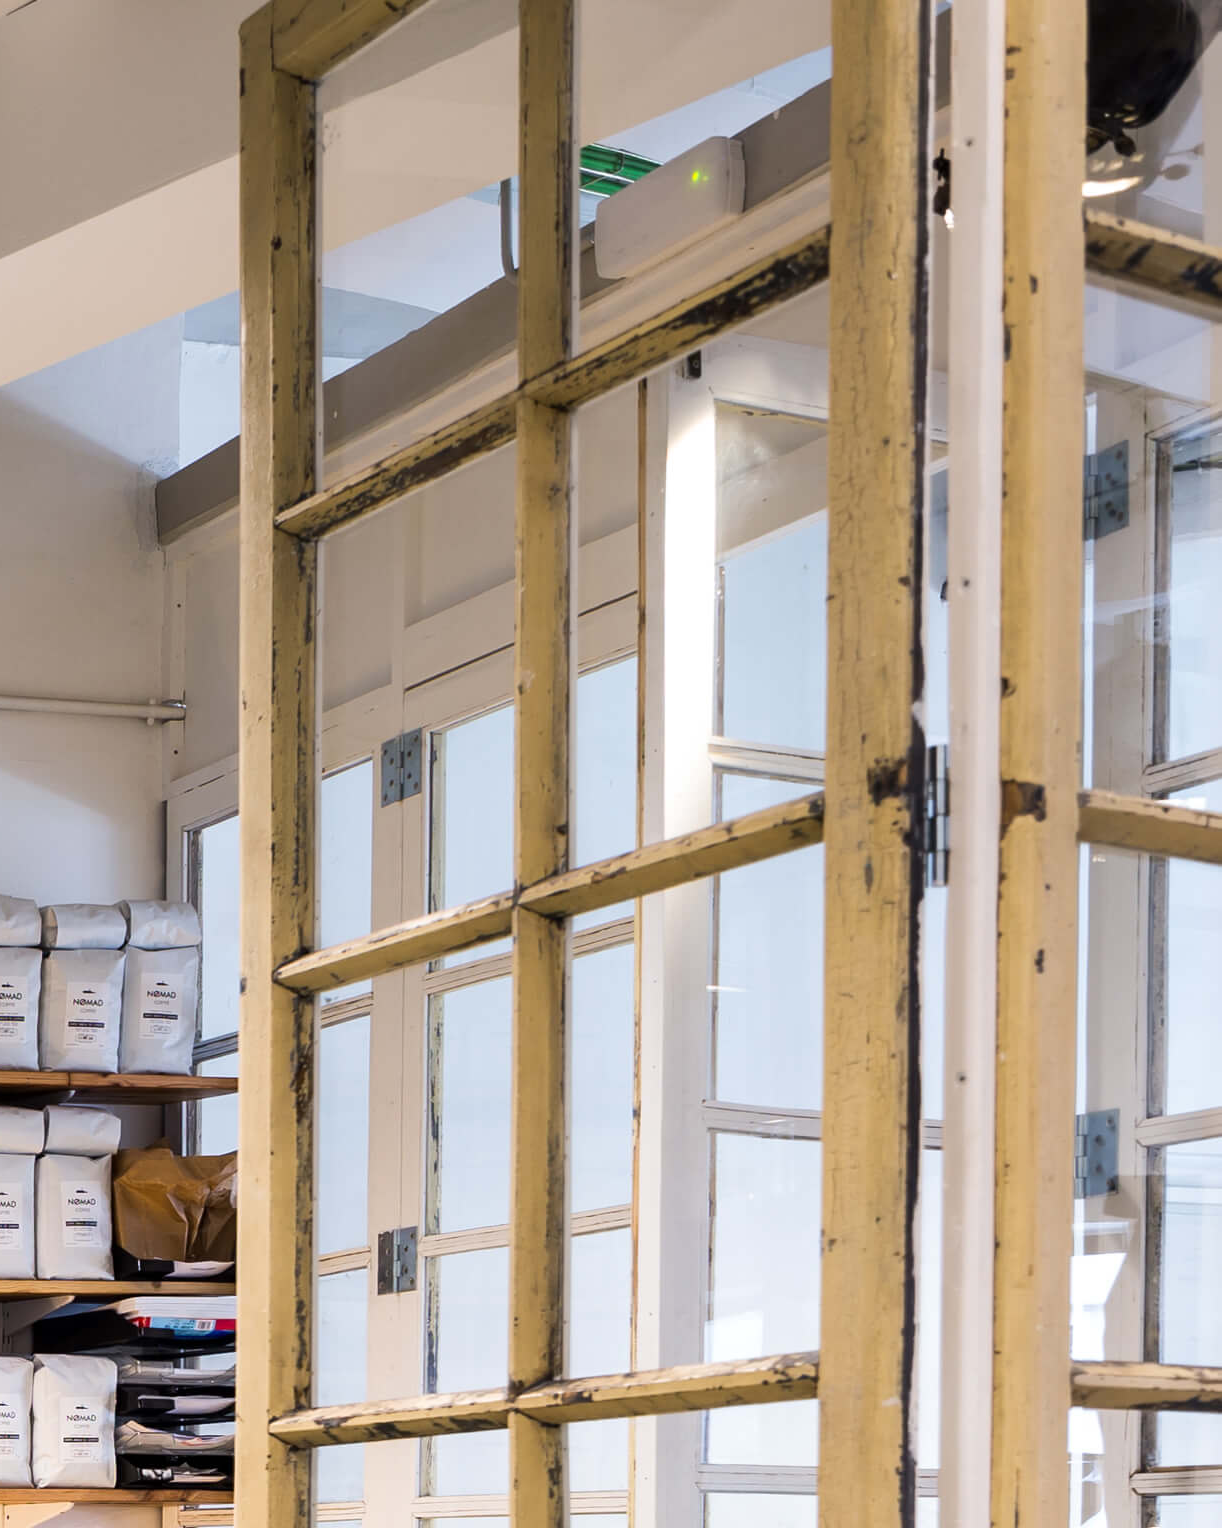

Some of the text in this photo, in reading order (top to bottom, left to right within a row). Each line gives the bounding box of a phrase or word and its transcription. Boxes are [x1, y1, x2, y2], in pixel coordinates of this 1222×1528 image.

[147, 991, 176, 999] NØMAD
[68, 1198, 96, 1206] NØMAD
[66, 1414, 96, 1422] NØMAD
